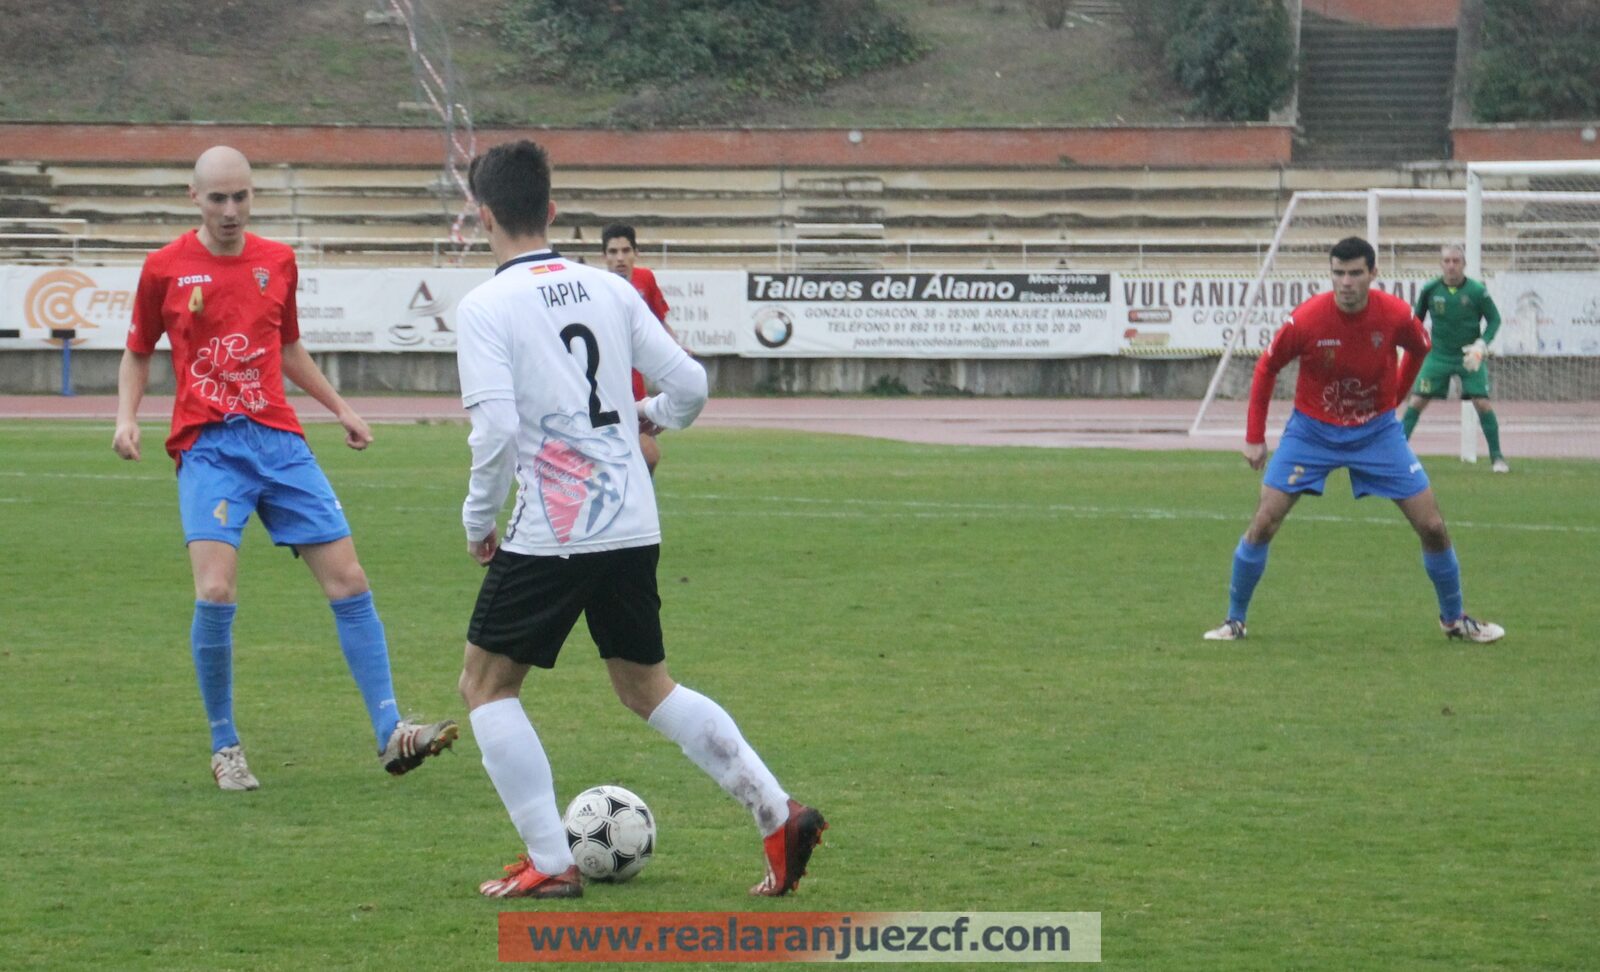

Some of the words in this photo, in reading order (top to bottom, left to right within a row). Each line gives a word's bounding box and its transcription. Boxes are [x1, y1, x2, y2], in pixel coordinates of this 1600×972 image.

[537, 280, 591, 308] TAPIA
[753, 275, 863, 299] Talleres
[871, 275, 916, 299] del
[921, 271, 1015, 299] Álamo
[804, 307, 863, 319] GONZALO
[985, 308, 1049, 319] ARANJUEZ
[559, 323, 620, 428] 2
[213, 499, 229, 527] 4
